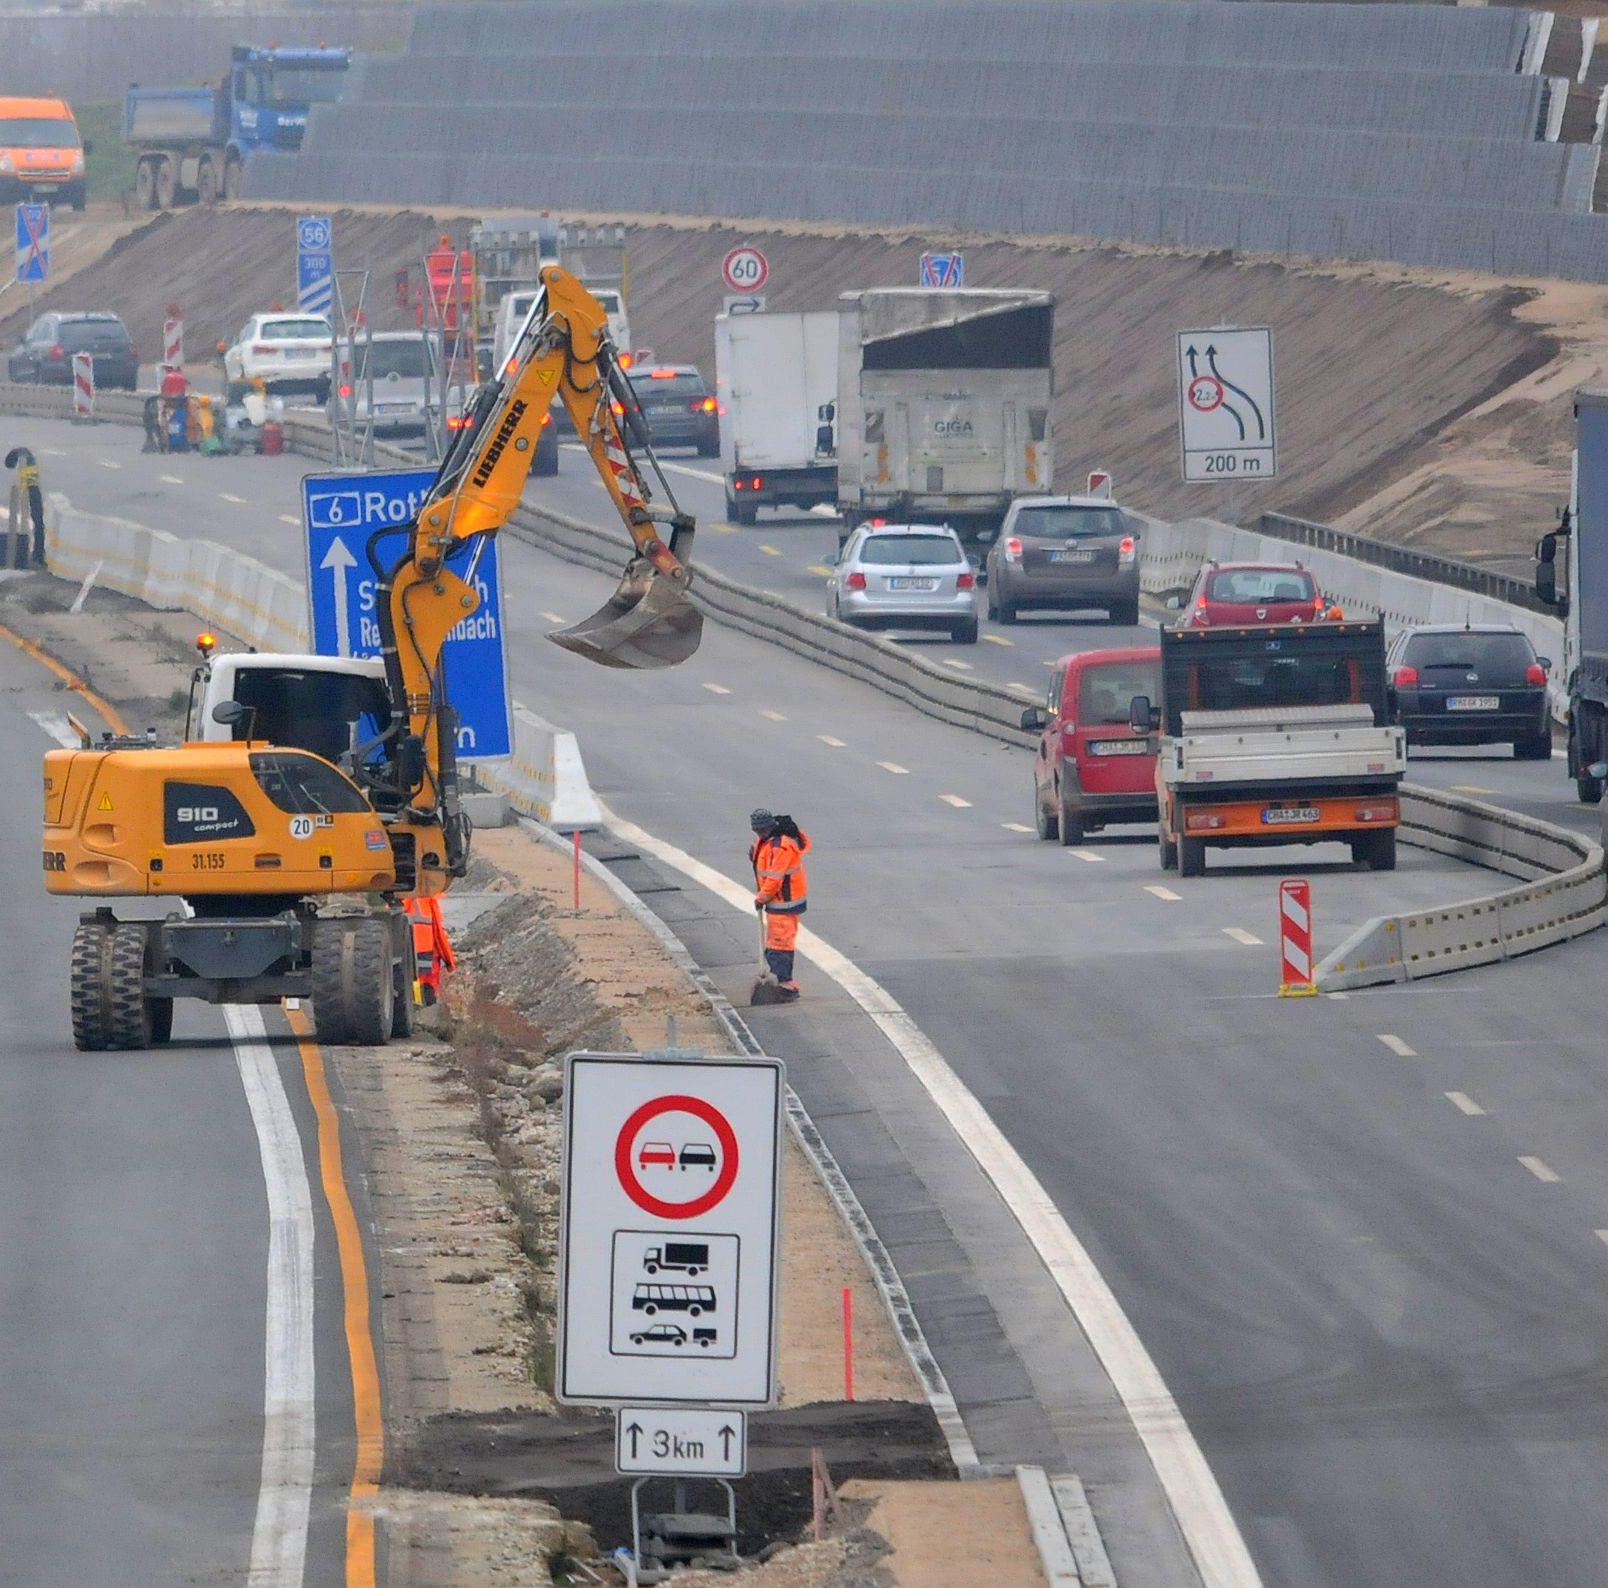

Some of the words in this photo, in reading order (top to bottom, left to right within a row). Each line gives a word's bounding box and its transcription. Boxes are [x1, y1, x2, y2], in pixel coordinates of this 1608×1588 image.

[304, 227, 324, 243] 56
[733, 259, 757, 279] 60
[934, 420, 973, 434] GIGA
[472, 399, 529, 489] LIEBHERR
[1205, 455, 1237, 473] 200
[1243, 457, 1261, 471] m
[328, 497, 343, 524] 6
[176, 806, 220, 823] 910
[193, 818, 240, 833] compact
[294, 819, 310, 835] 20
[192, 852, 226, 870] 31.155
